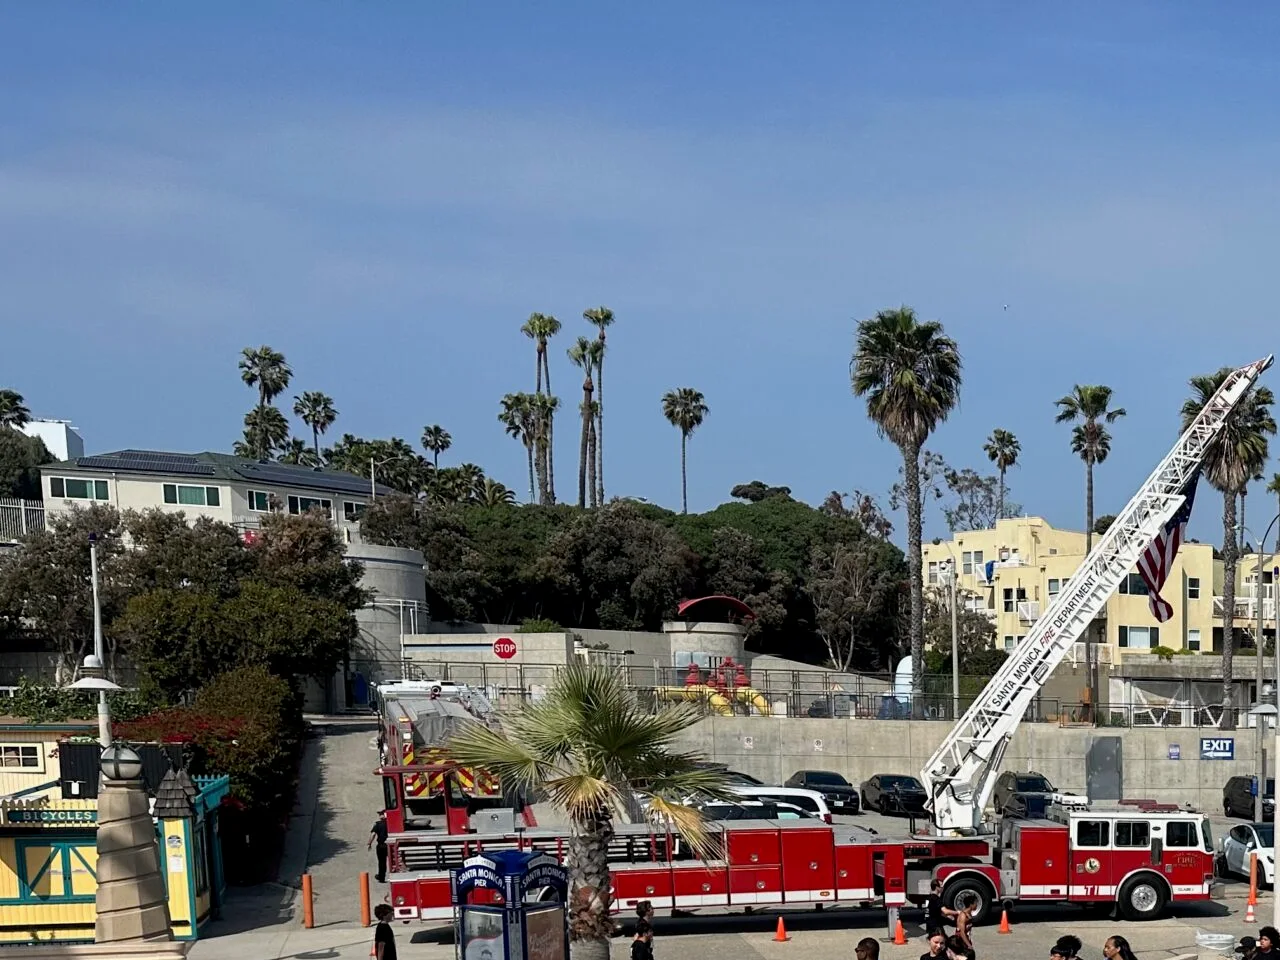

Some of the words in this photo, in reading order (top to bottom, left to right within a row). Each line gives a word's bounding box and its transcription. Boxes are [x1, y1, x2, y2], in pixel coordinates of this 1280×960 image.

[991, 680, 1016, 707] SANTA
[1013, 647, 1042, 680] MONICA
[1039, 626, 1056, 649] FIRE
[1053, 575, 1096, 629] DEPARTMENT
[494, 644, 515, 653] STOP
[1202, 740, 1232, 751] EXIT
[23, 811, 92, 820] BICYCLES
[458, 868, 477, 885] SANTA
[477, 868, 503, 888] MONICA
[522, 868, 541, 888] SANTA
[541, 867, 566, 881] MONICA
[538, 877, 551, 885] PIER
[474, 879, 487, 887] PIER
